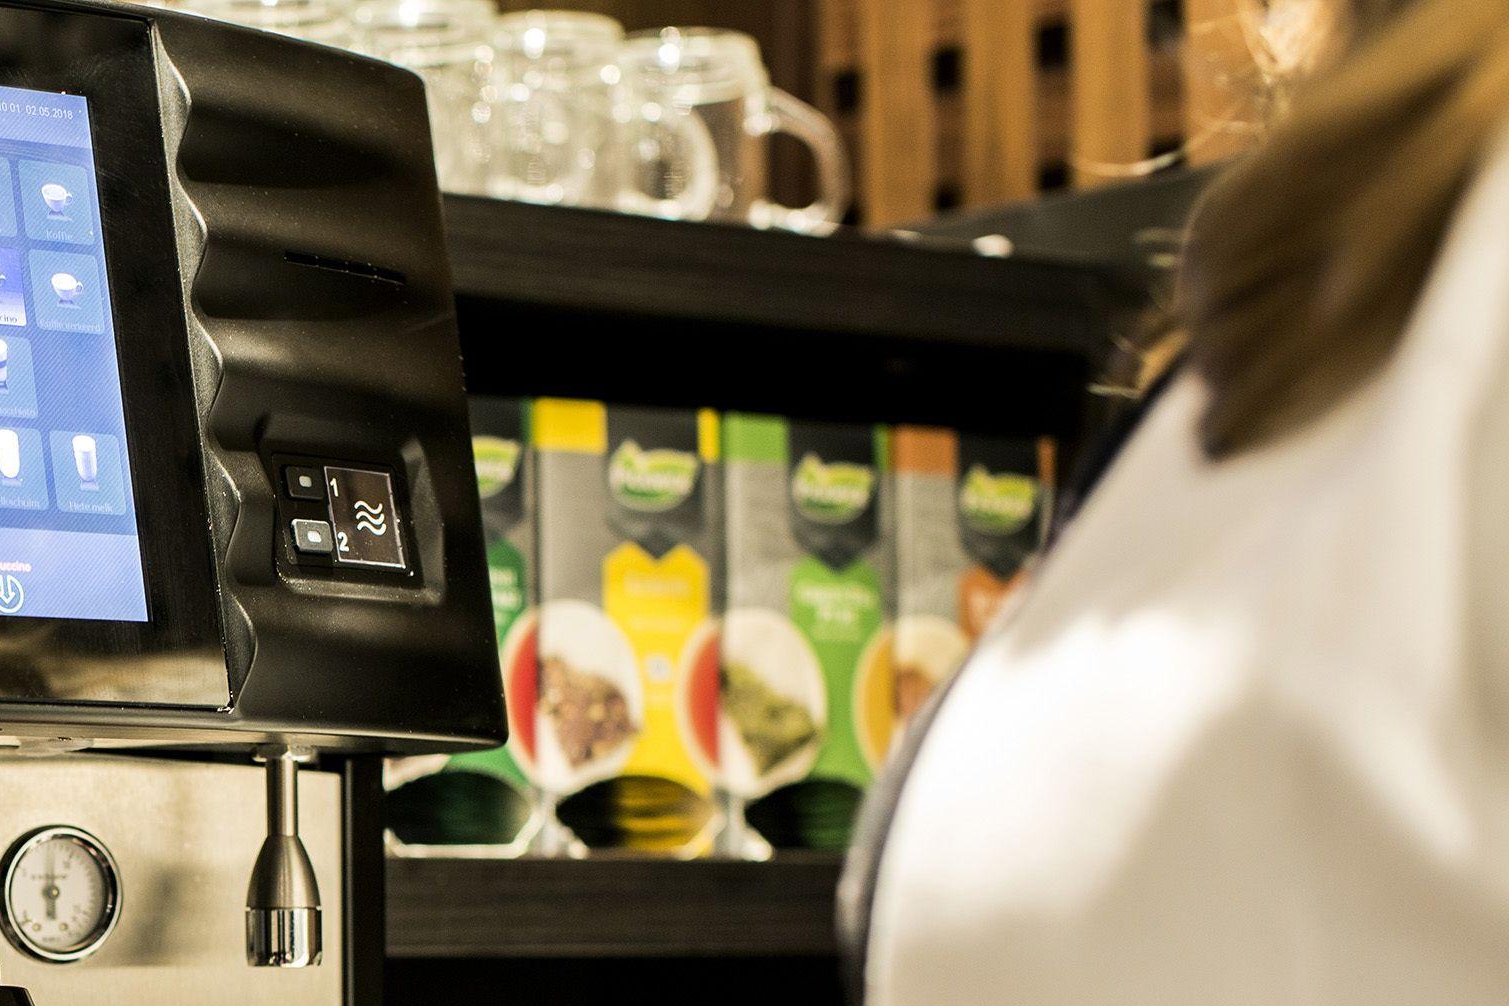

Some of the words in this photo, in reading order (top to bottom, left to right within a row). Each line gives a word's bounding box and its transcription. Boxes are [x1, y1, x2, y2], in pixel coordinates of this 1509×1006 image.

[46, 230, 74, 241] Koffie
[330, 477, 339, 497] 1
[337, 531, 350, 552] 2
